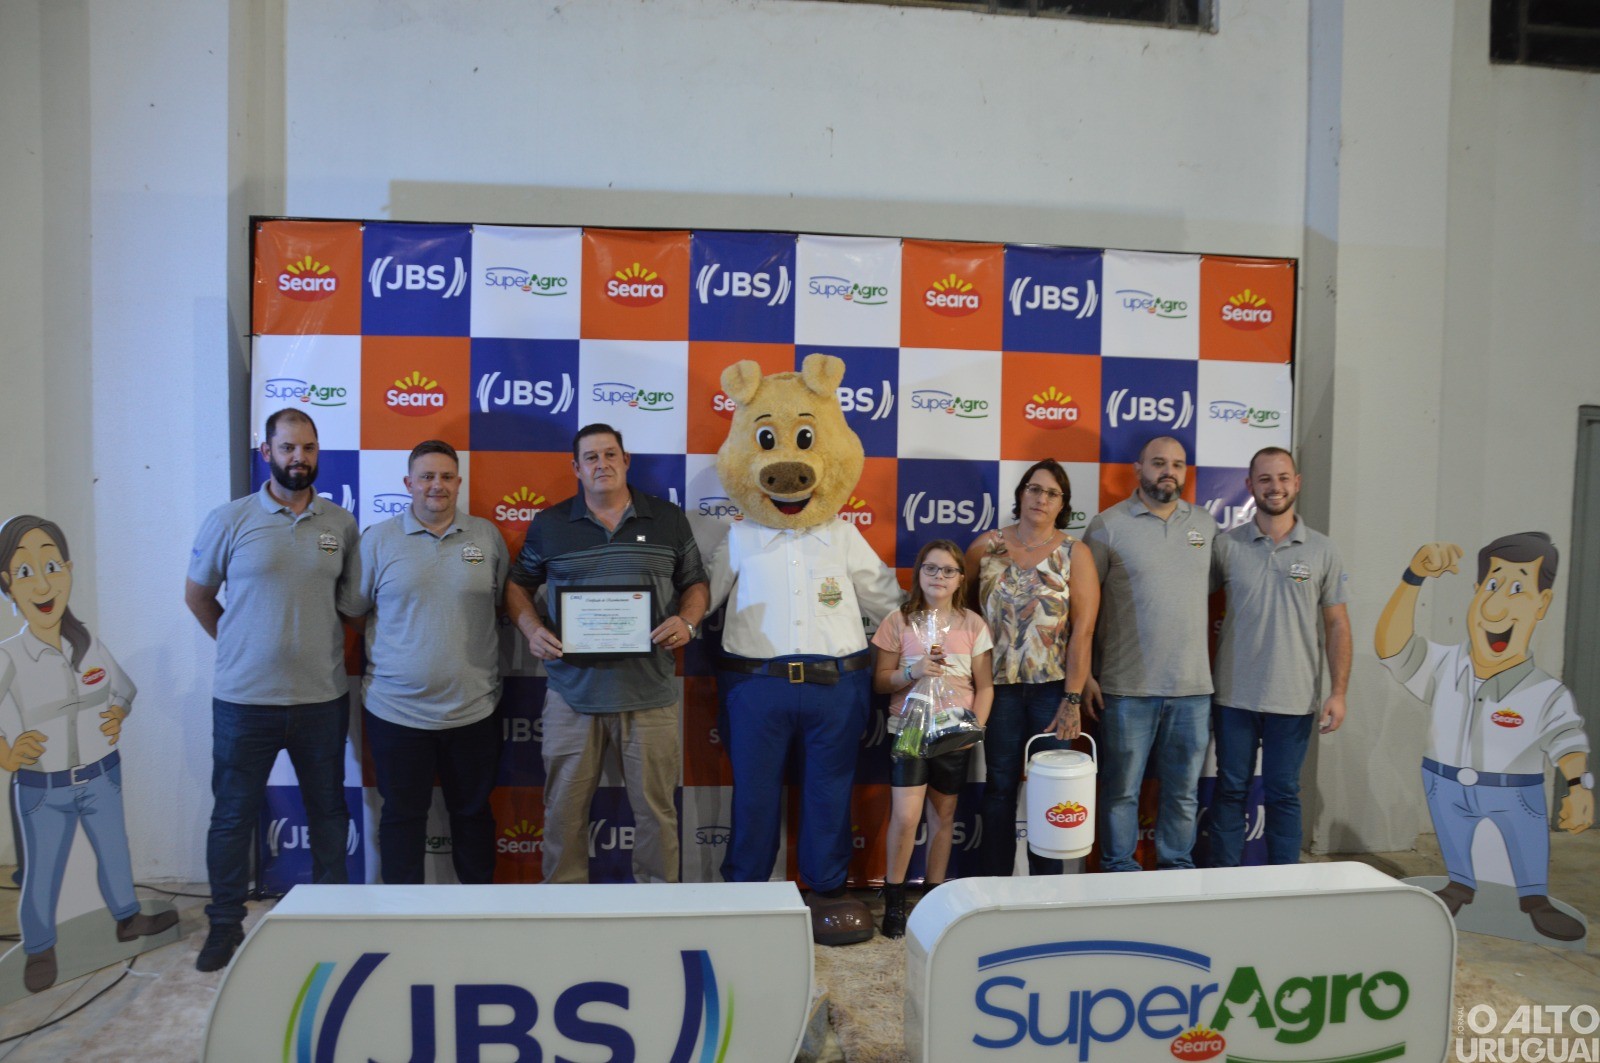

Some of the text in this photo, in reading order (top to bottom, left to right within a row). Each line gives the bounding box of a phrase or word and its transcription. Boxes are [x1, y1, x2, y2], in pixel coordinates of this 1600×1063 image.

[278, 272, 336, 292] Seara
[386, 265, 447, 291] JBS
[606, 279, 664, 299] Seara
[713, 271, 772, 298] JBS
[925, 288, 979, 310] Seara
[1026, 285, 1079, 311] JBS
[1222, 302, 1273, 323] Seara
[386, 386, 444, 408] Seara
[494, 379, 553, 407] JBS
[836, 386, 875, 413] BS
[1025, 403, 1078, 423] Seara
[1122, 396, 1176, 423] JBS
[495, 504, 545, 522] Sear
[920, 499, 975, 526] JBS
[1492, 713, 1523, 725] Seara
[1047, 811, 1086, 823] Seara
[497, 837, 544, 854] Sear
[601, 826, 635, 850] JB
[366, 980, 638, 1063] JBS
[1172, 1040, 1222, 1055] Seara
